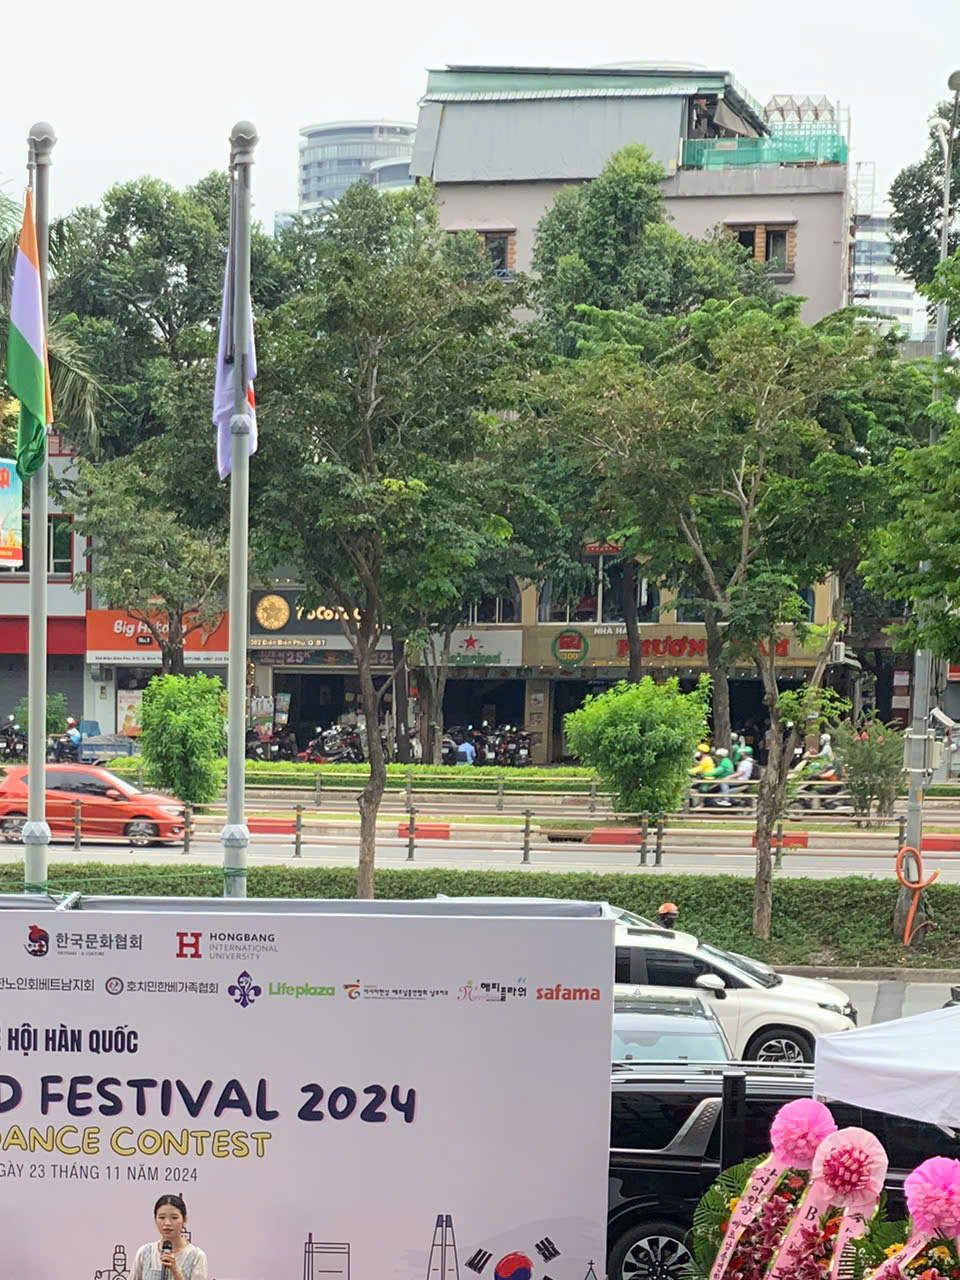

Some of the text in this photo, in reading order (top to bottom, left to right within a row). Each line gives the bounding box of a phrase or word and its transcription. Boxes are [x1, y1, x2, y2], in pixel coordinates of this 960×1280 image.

[113, 619, 135, 637] Big
[55, 932, 143, 951] 한국문화협회
[209, 932, 276, 943] HONGBANG
[209, 943, 279, 953] INTERNATIONAL
[209, 952, 261, 961] UNIVERSITY
[126, 980, 219, 994] 호치민한베가족협회
[268, 982, 336, 999] Lifeplaza
[536, 983, 601, 1001] safama
[7, 1022, 38, 1057] HỘI
[44, 1023, 82, 1053] HÀN
[88, 1024, 139, 1055] QUỐC
[40, 1074, 280, 1122] FESTIVAL
[296, 1082, 417, 1124] 2024
[110, 1126, 273, 1159] CONTEST
[29, 1164, 46, 1179] 23
[50, 1162, 101, 1180] THÁNG
[104, 1165, 121, 1181] 11
[126, 1162, 159, 1182] NĂM
[164, 1166, 199, 1183] 2024
